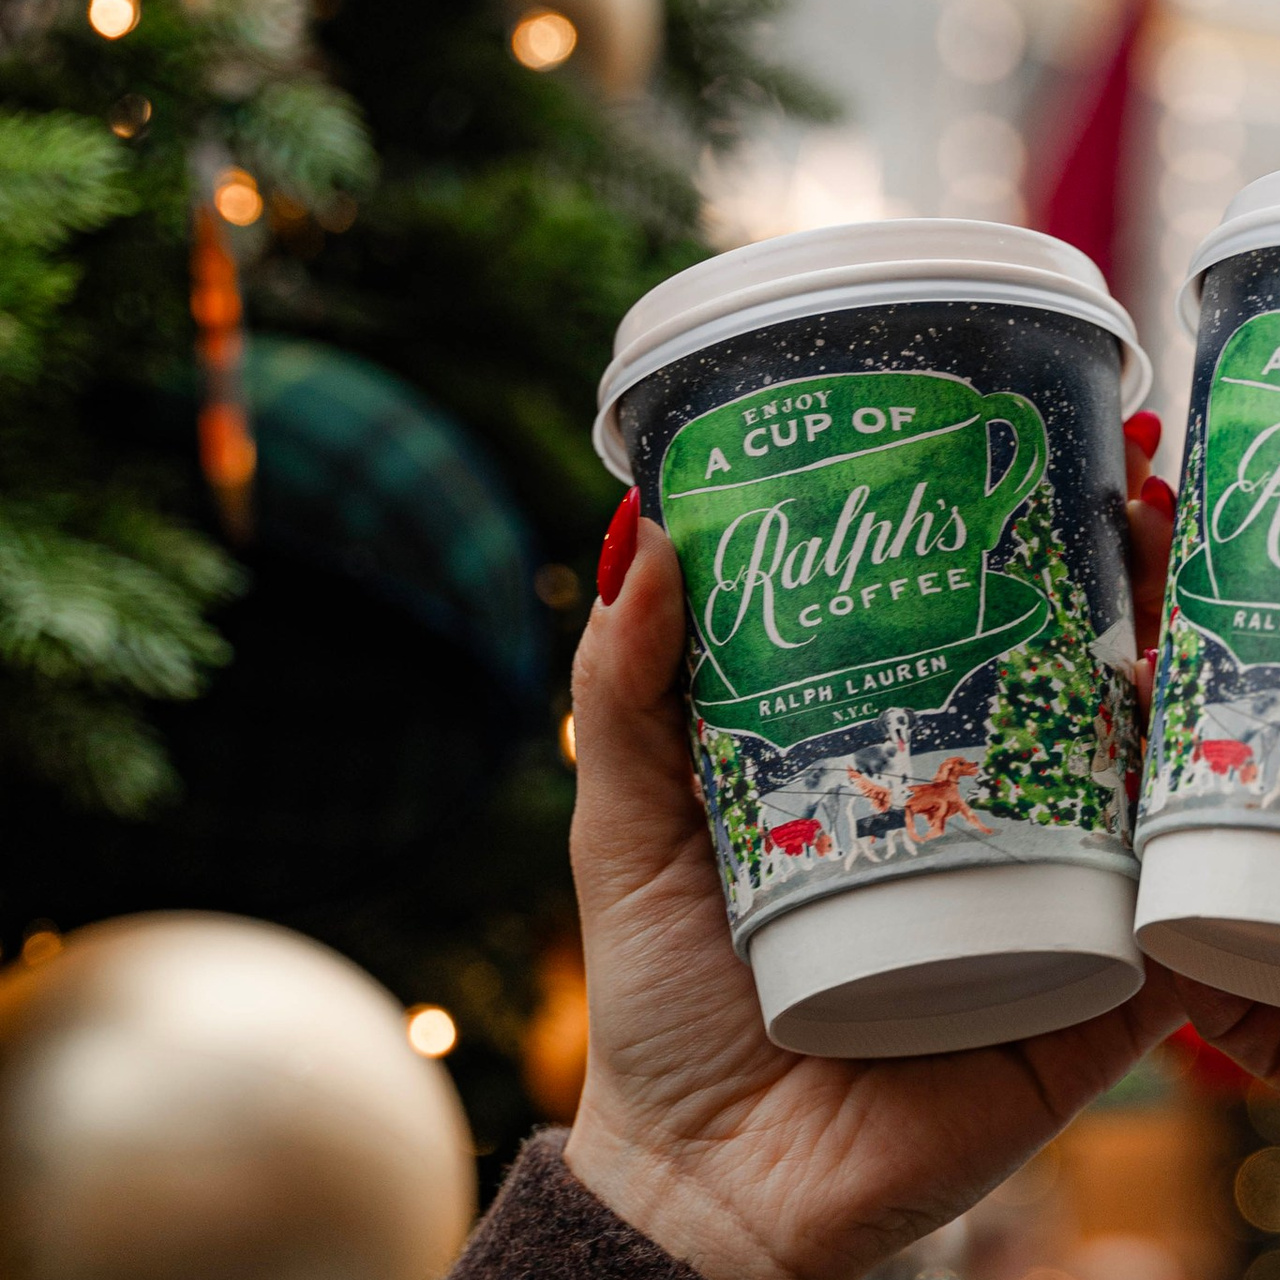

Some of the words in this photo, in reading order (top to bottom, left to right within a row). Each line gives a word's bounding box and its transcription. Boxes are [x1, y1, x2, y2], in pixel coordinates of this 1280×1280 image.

[742, 390, 833, 426] ENJOY
[704, 447, 731, 479] A
[743, 413, 832, 457] CUP
[852, 407, 916, 435] OF
[705, 482, 967, 649] Ralph's
[799, 568, 972, 628] COFFEE
[758, 685, 833, 717] RALPH
[845, 655, 948, 696] LAUREN
[832, 702, 879, 725] N.Y.C.
